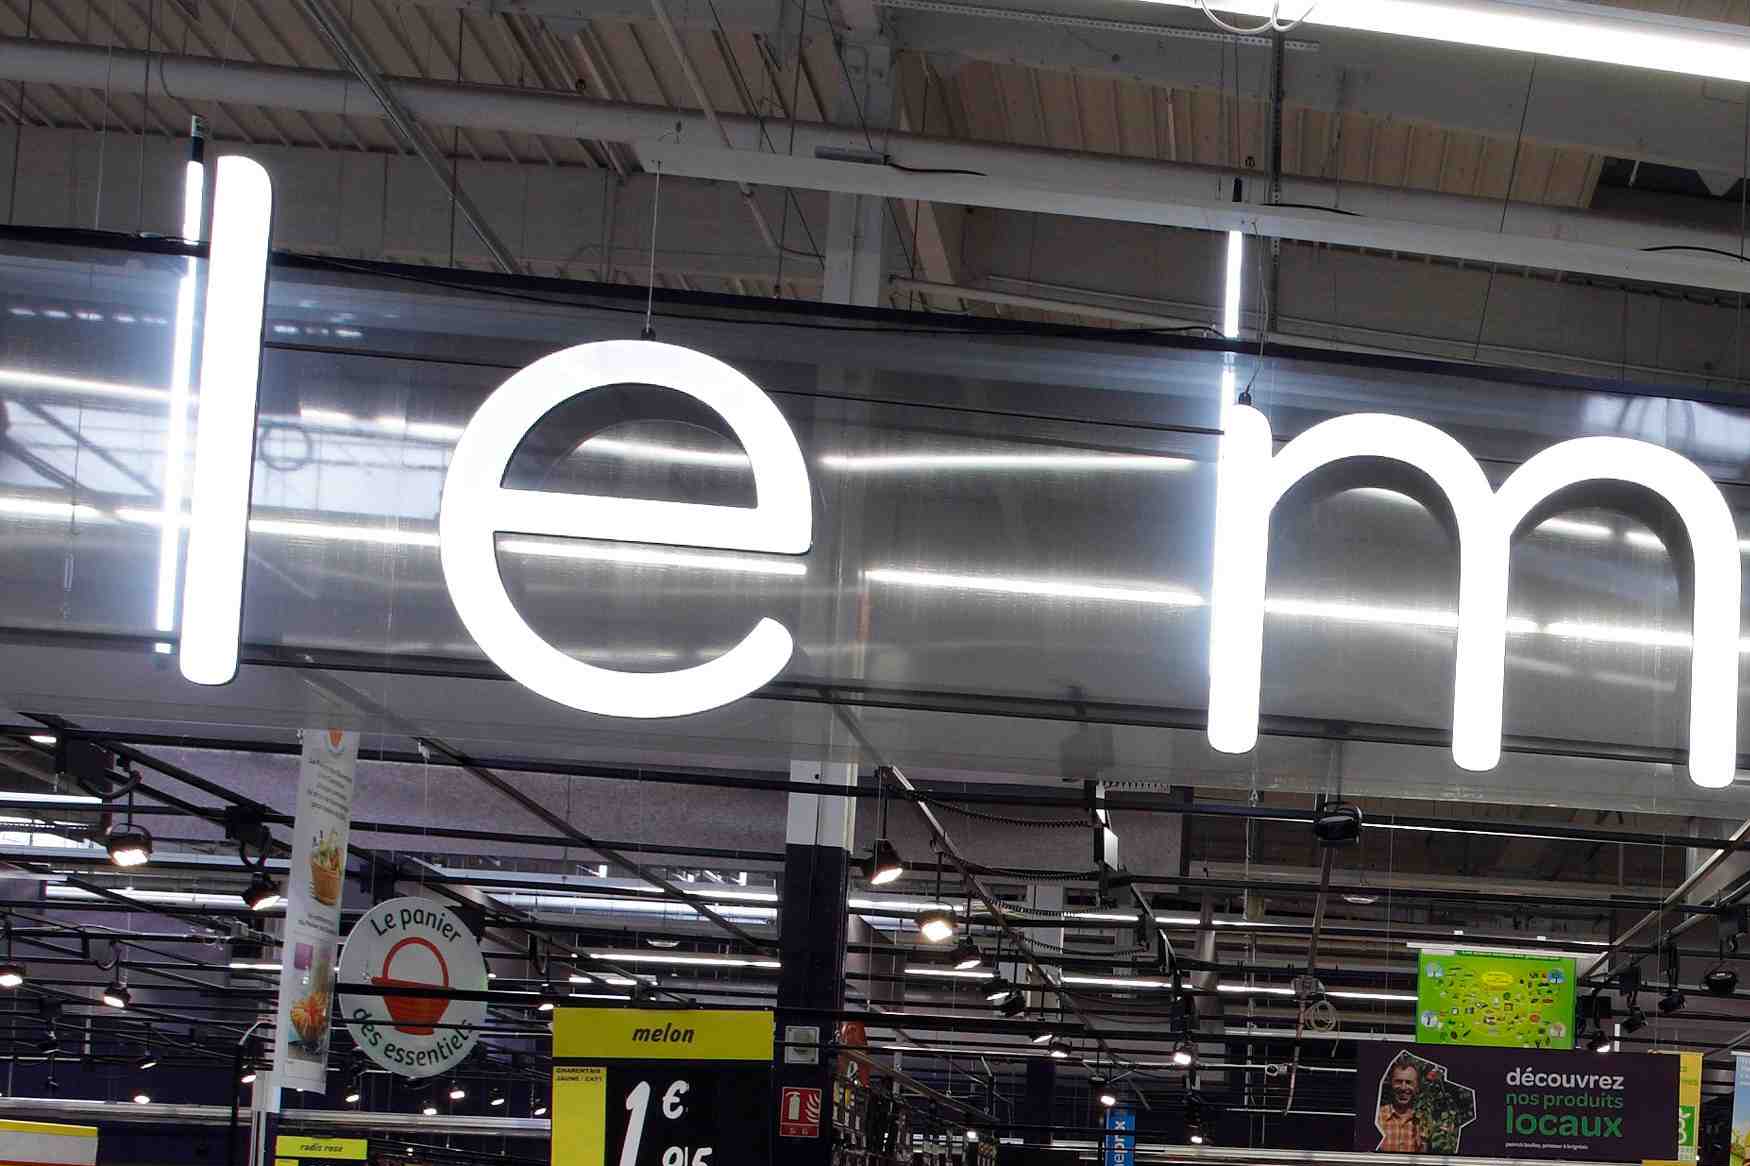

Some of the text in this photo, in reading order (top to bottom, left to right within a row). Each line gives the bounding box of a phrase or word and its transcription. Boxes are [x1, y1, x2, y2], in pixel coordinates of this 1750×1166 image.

[178, 154, 815, 721] le
[371, 912, 397, 936] Le
[400, 908, 462, 943] panier
[353, 1008, 383, 1046] des
[632, 1023, 696, 1045] melon
[1506, 1067, 1625, 1090] découvrez
[1506, 1091, 1624, 1110] nos produits
[1505, 1104, 1623, 1138] locaux
